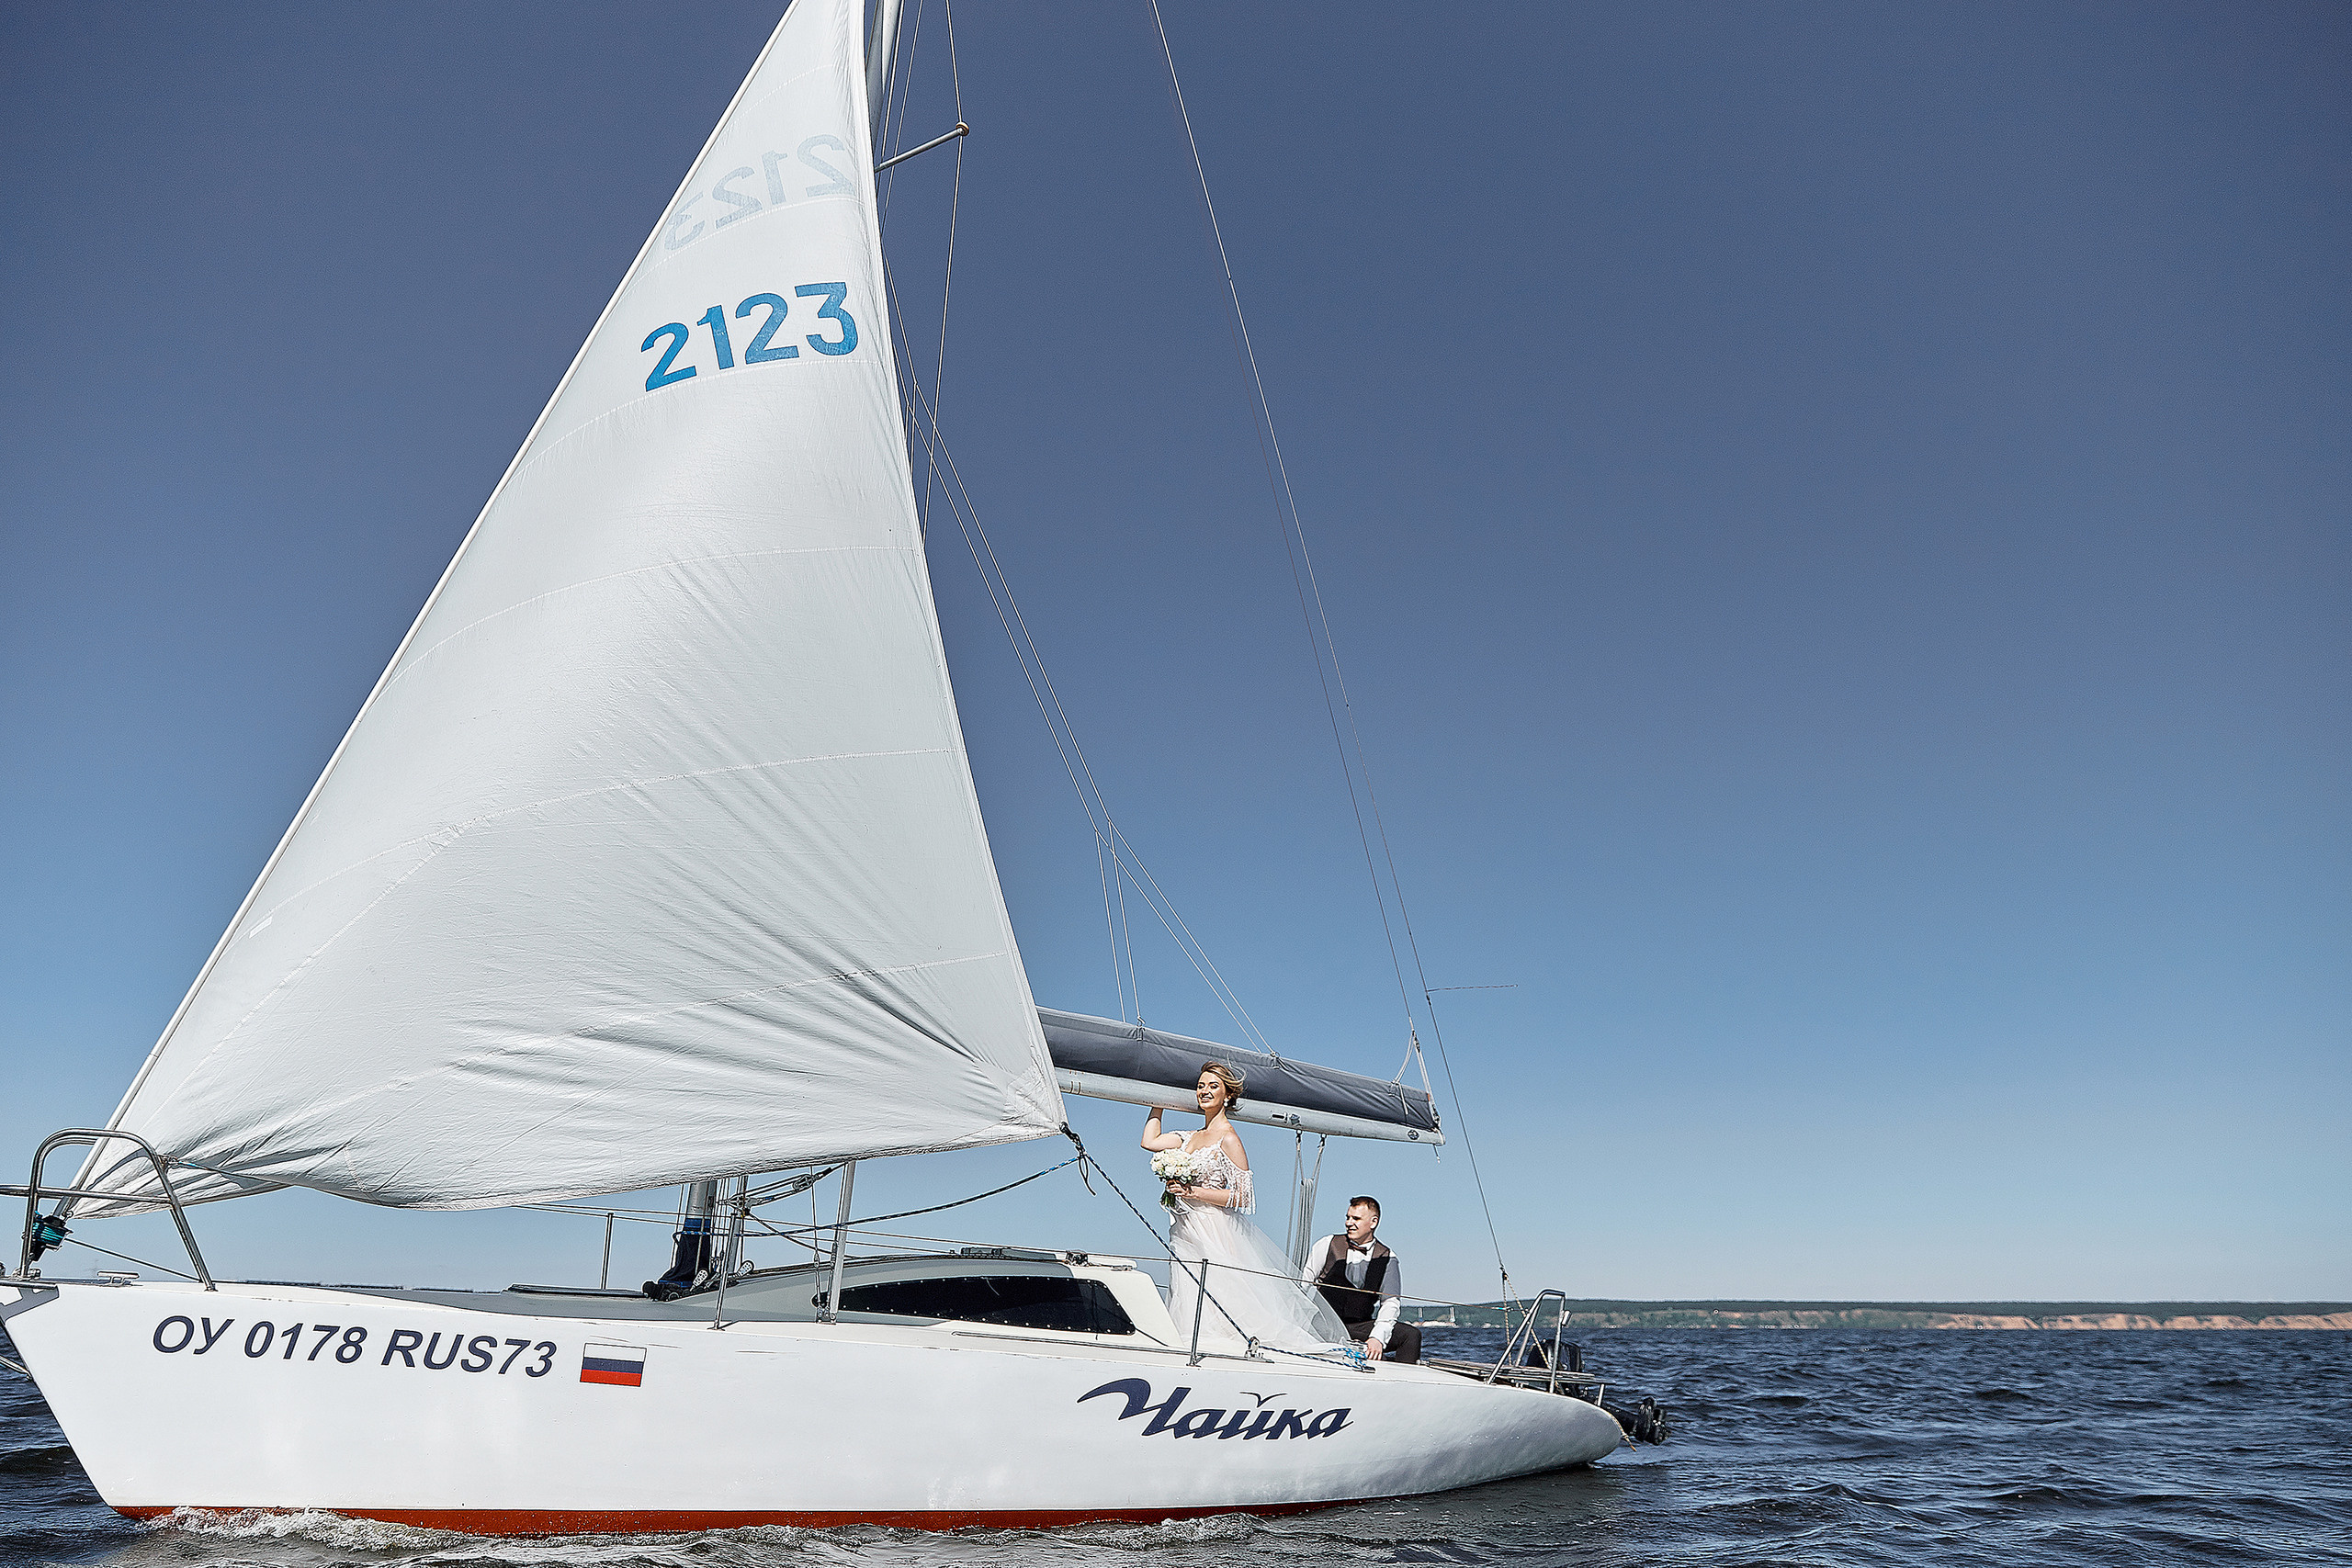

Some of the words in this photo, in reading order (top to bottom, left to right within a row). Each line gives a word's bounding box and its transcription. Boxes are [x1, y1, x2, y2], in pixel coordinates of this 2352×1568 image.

[640, 281, 858, 392] 2123
[244, 1321, 368, 1364] 0178
[381, 1328, 557, 1377] RUS73
[1077, 1377, 1354, 1440] Чайка
